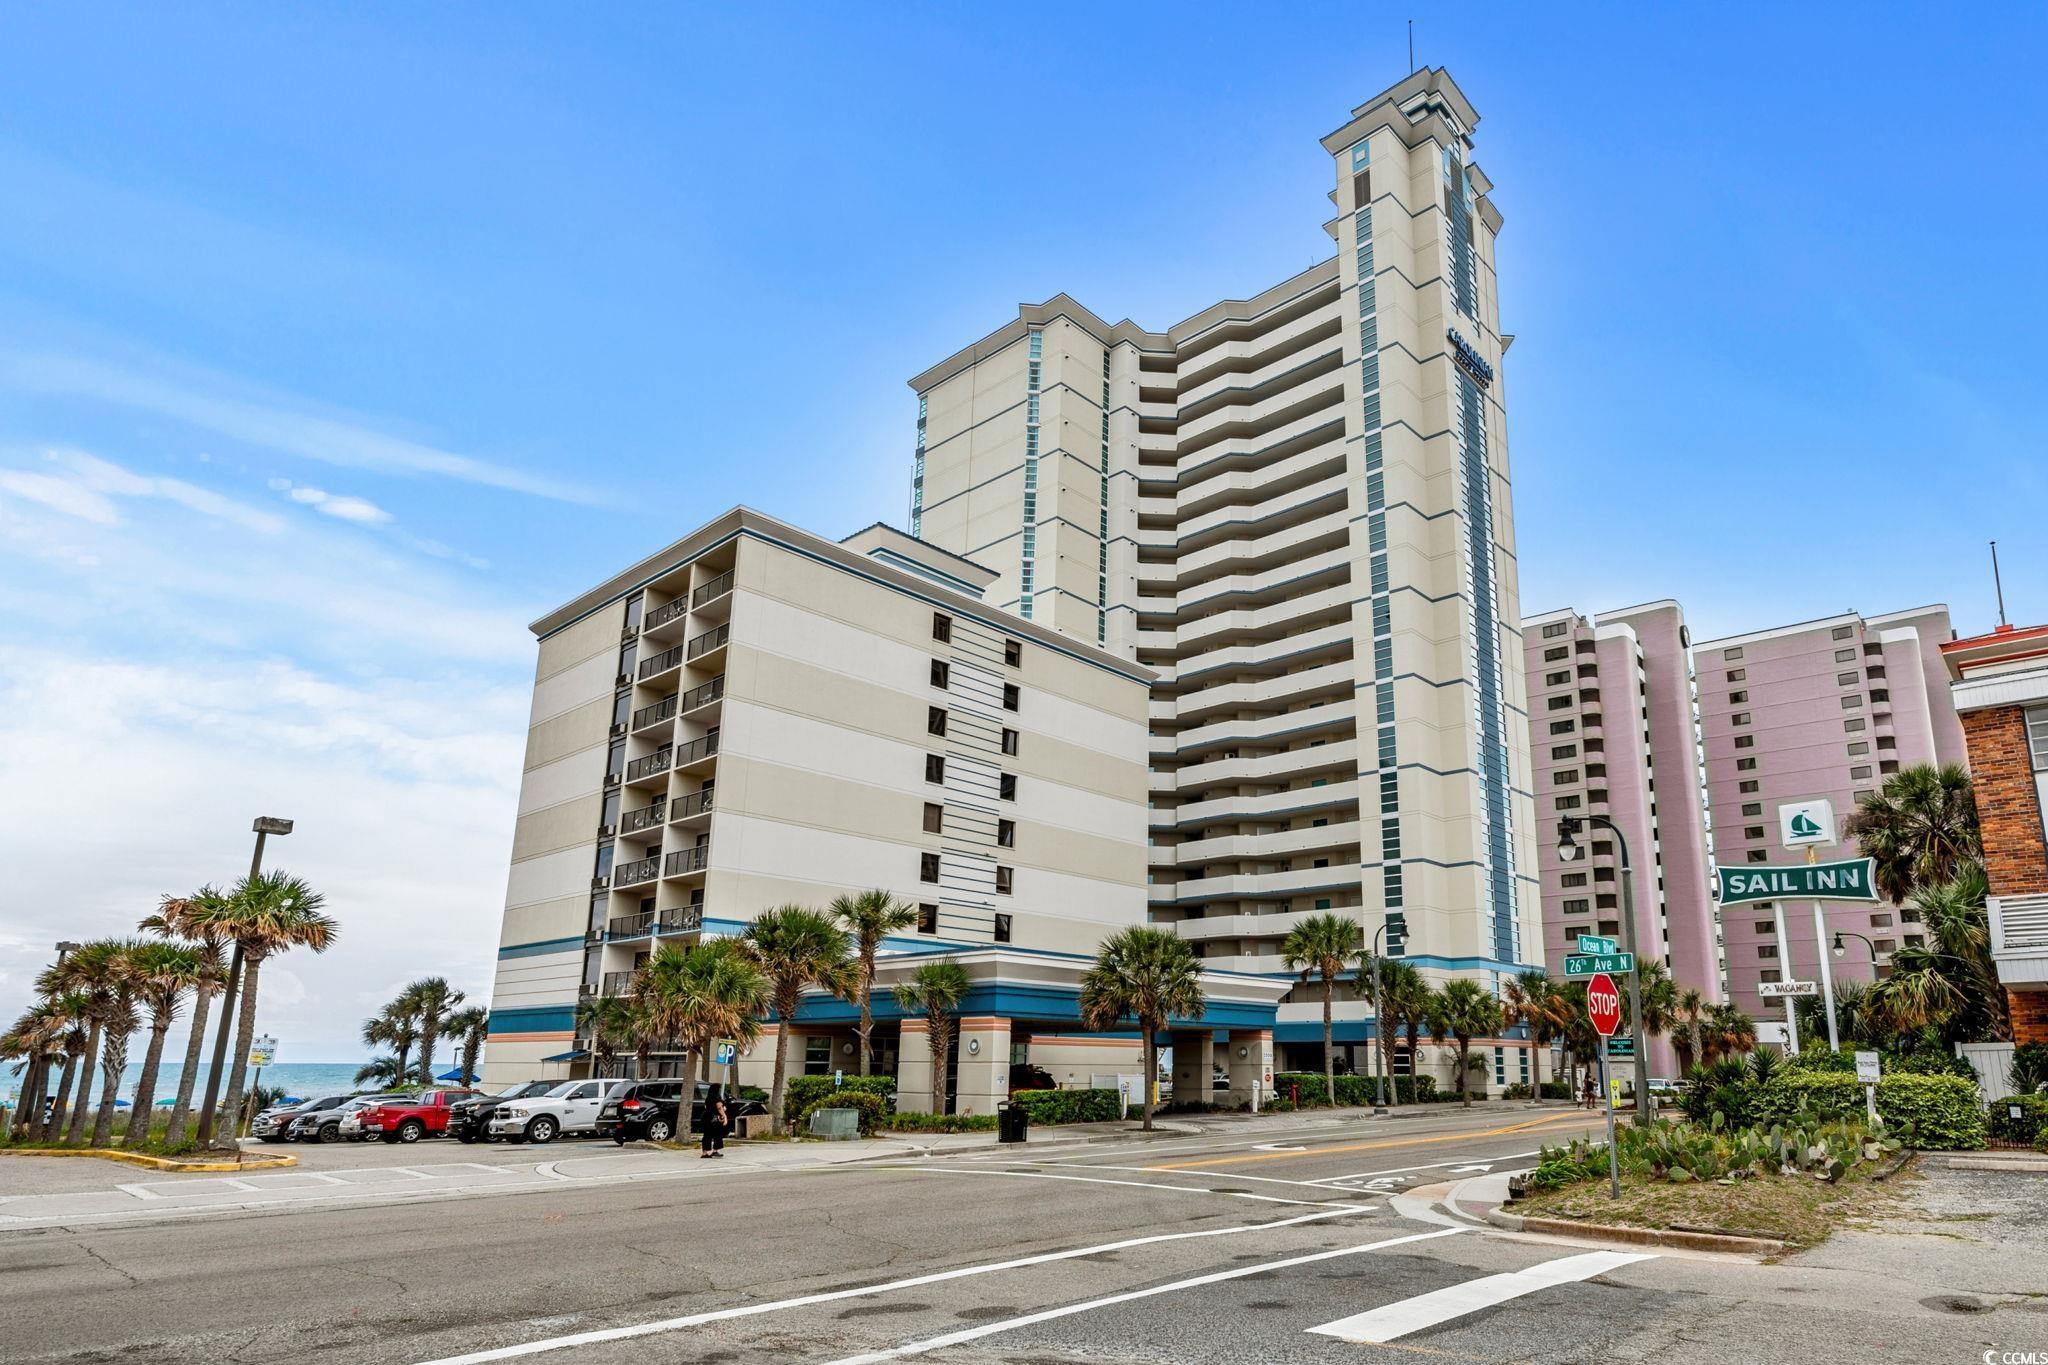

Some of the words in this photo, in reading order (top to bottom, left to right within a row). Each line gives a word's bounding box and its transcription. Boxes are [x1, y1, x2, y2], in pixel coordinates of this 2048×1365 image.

[1729, 872, 1798, 894] SAIL
[1806, 868, 1860, 890] INN
[1582, 937, 1600, 953] Ocean
[1603, 940, 1614, 954] Blvd
[1594, 958, 1612, 971] Ave
[1620, 955, 1628, 970] N
[1774, 983, 1813, 993] VACANCY
[1590, 991, 1617, 1016] STOP
[726, 1044, 735, 1064] P
